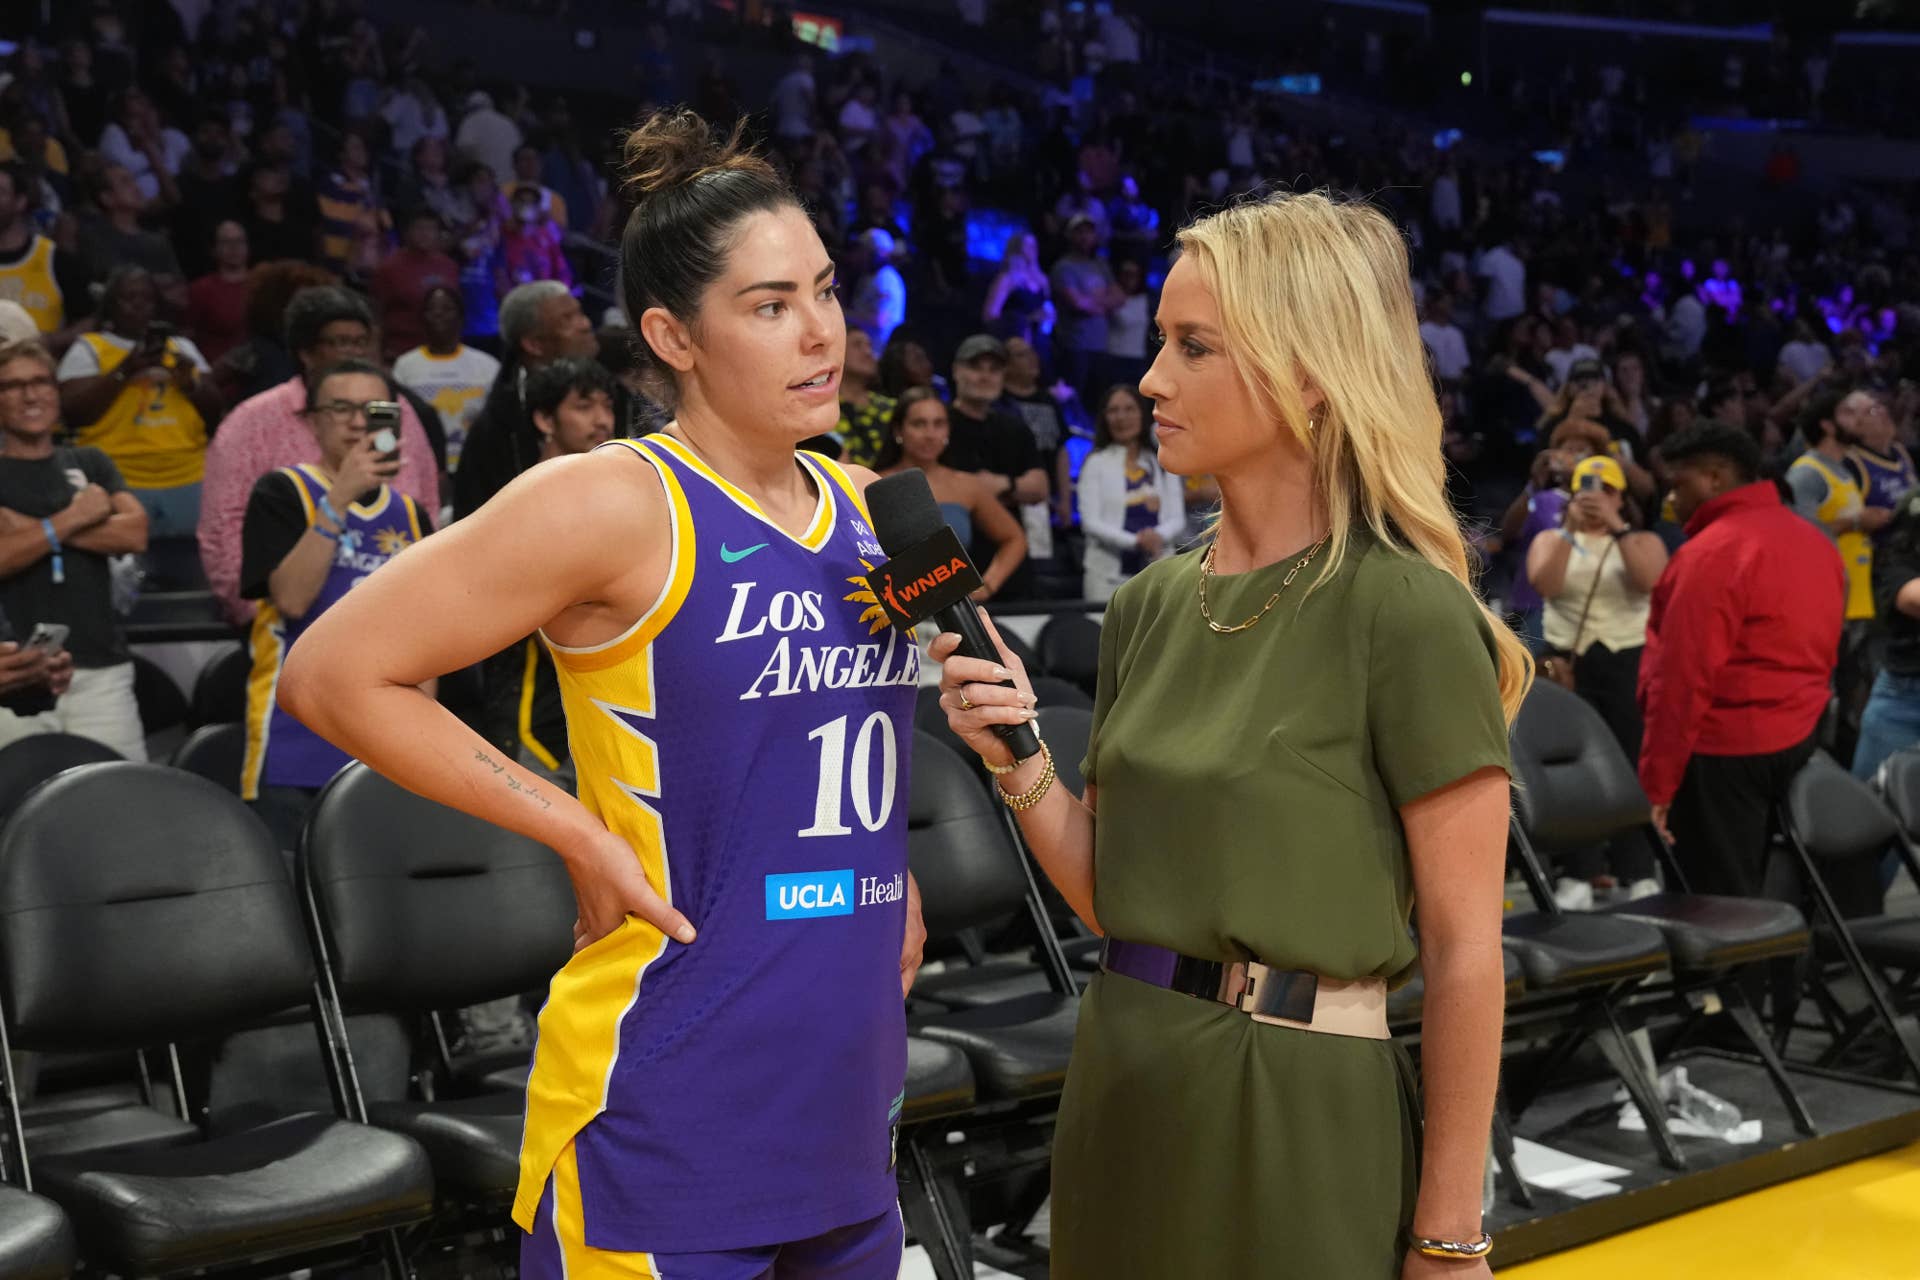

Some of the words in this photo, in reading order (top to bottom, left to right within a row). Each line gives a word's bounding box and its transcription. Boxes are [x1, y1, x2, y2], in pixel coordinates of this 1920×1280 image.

[898, 557, 967, 602] WNBA
[739, 624, 920, 700] ANGELE
[798, 711, 897, 837] 10
[779, 882, 846, 910] UCLA
